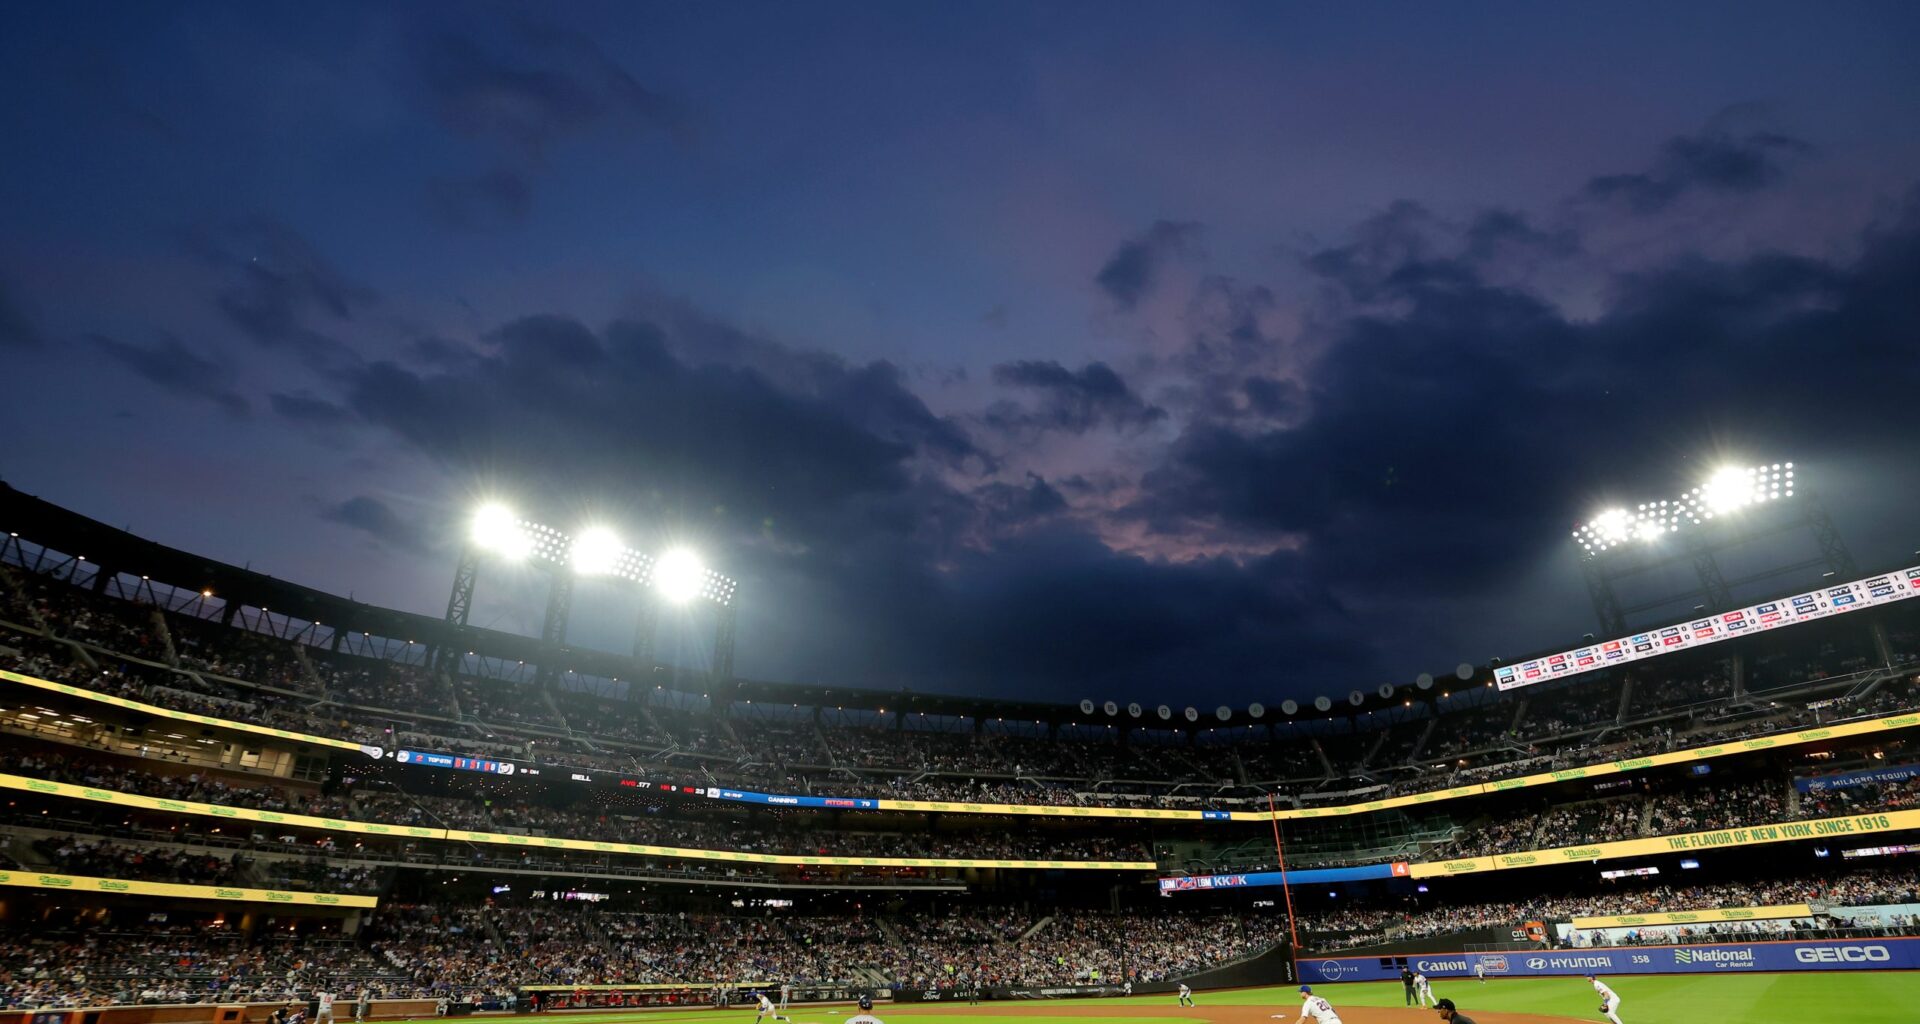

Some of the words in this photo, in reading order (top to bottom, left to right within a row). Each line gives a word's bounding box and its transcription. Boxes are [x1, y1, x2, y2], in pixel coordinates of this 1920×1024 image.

[571, 773, 591, 782] BELL
[1832, 775, 1873, 787] MILAGRO
[768, 796, 798, 804] CANNING
[1667, 837, 1688, 850] THE
[1691, 832, 1733, 848] FLAVOR
[1734, 831, 1748, 843] OF
[1751, 827, 1778, 841] NEW
[1780, 823, 1813, 839] YORK
[1814, 819, 1854, 835] SINCE
[1855, 815, 1890, 831] 1916
[1397, 865, 1405, 874] 4
[1161, 879, 1176, 889] LGM
[1197, 878, 1211, 887] LGM
[1692, 948, 1754, 962] National
[1795, 945, 1890, 963] GEICO
[1550, 957, 1612, 968] HYUNDAI
[1632, 955, 1650, 964] 358
[1417, 960, 1468, 972] Canon
[922, 991, 941, 1000] Ford
[1316, 1001, 1330, 1012] 20
